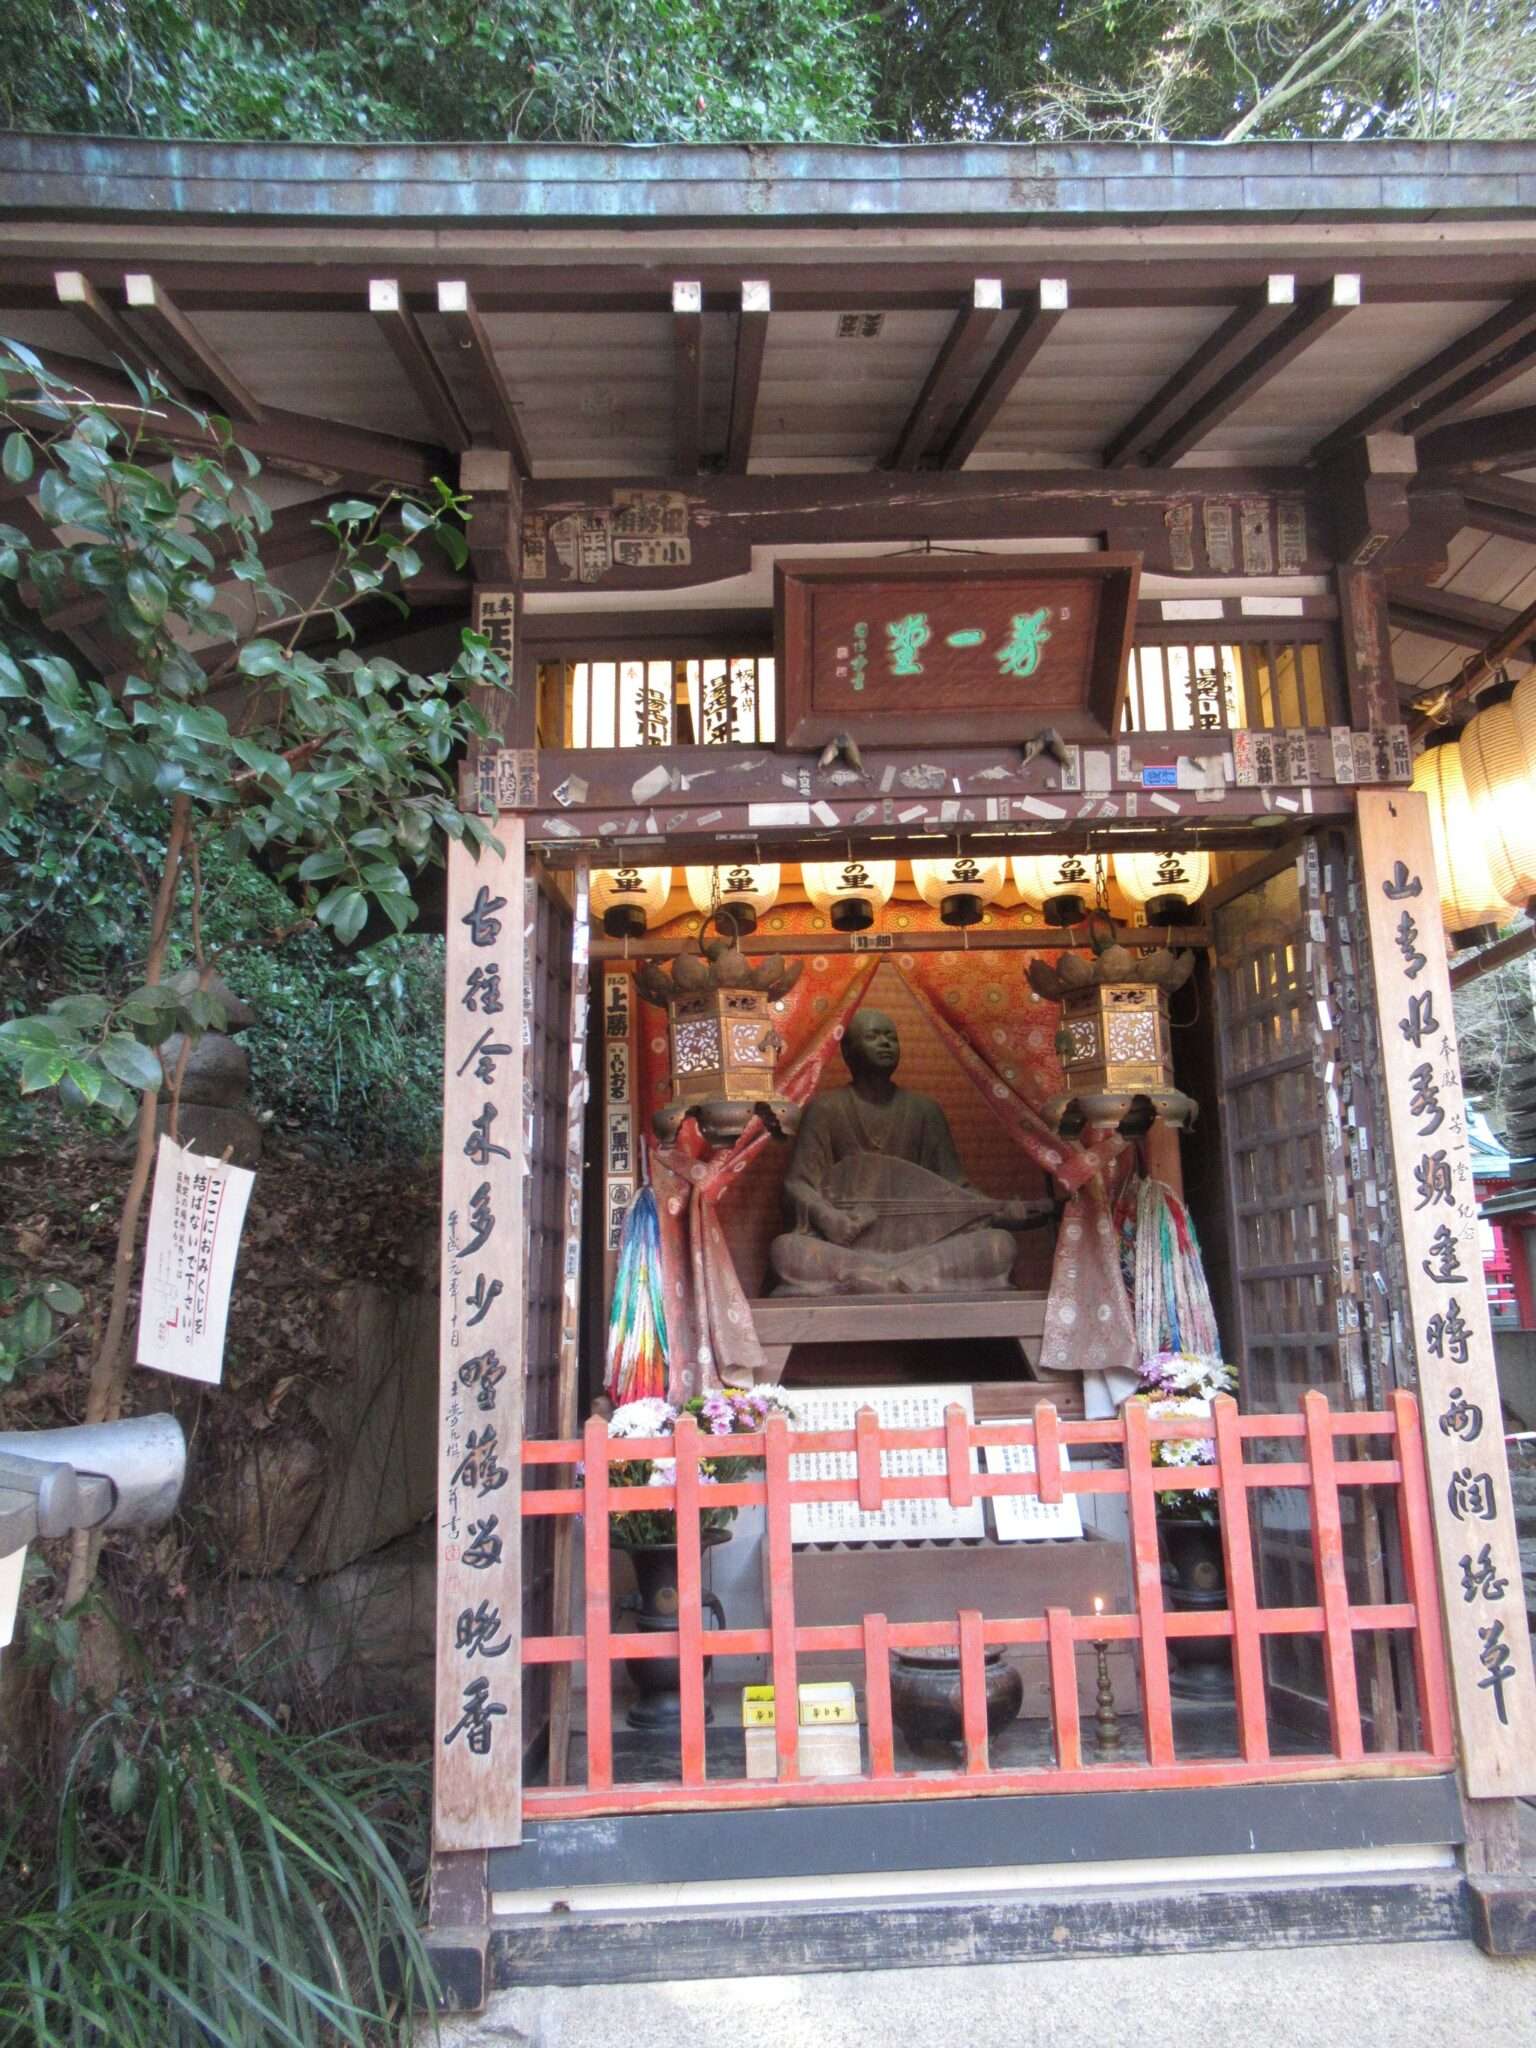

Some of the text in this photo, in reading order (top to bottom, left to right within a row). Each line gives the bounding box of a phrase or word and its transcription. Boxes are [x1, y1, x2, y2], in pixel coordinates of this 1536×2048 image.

[182, 1173, 207, 1344] 結ばないで下さい。
[194, 1179, 222, 1335] ここにおみくじを
